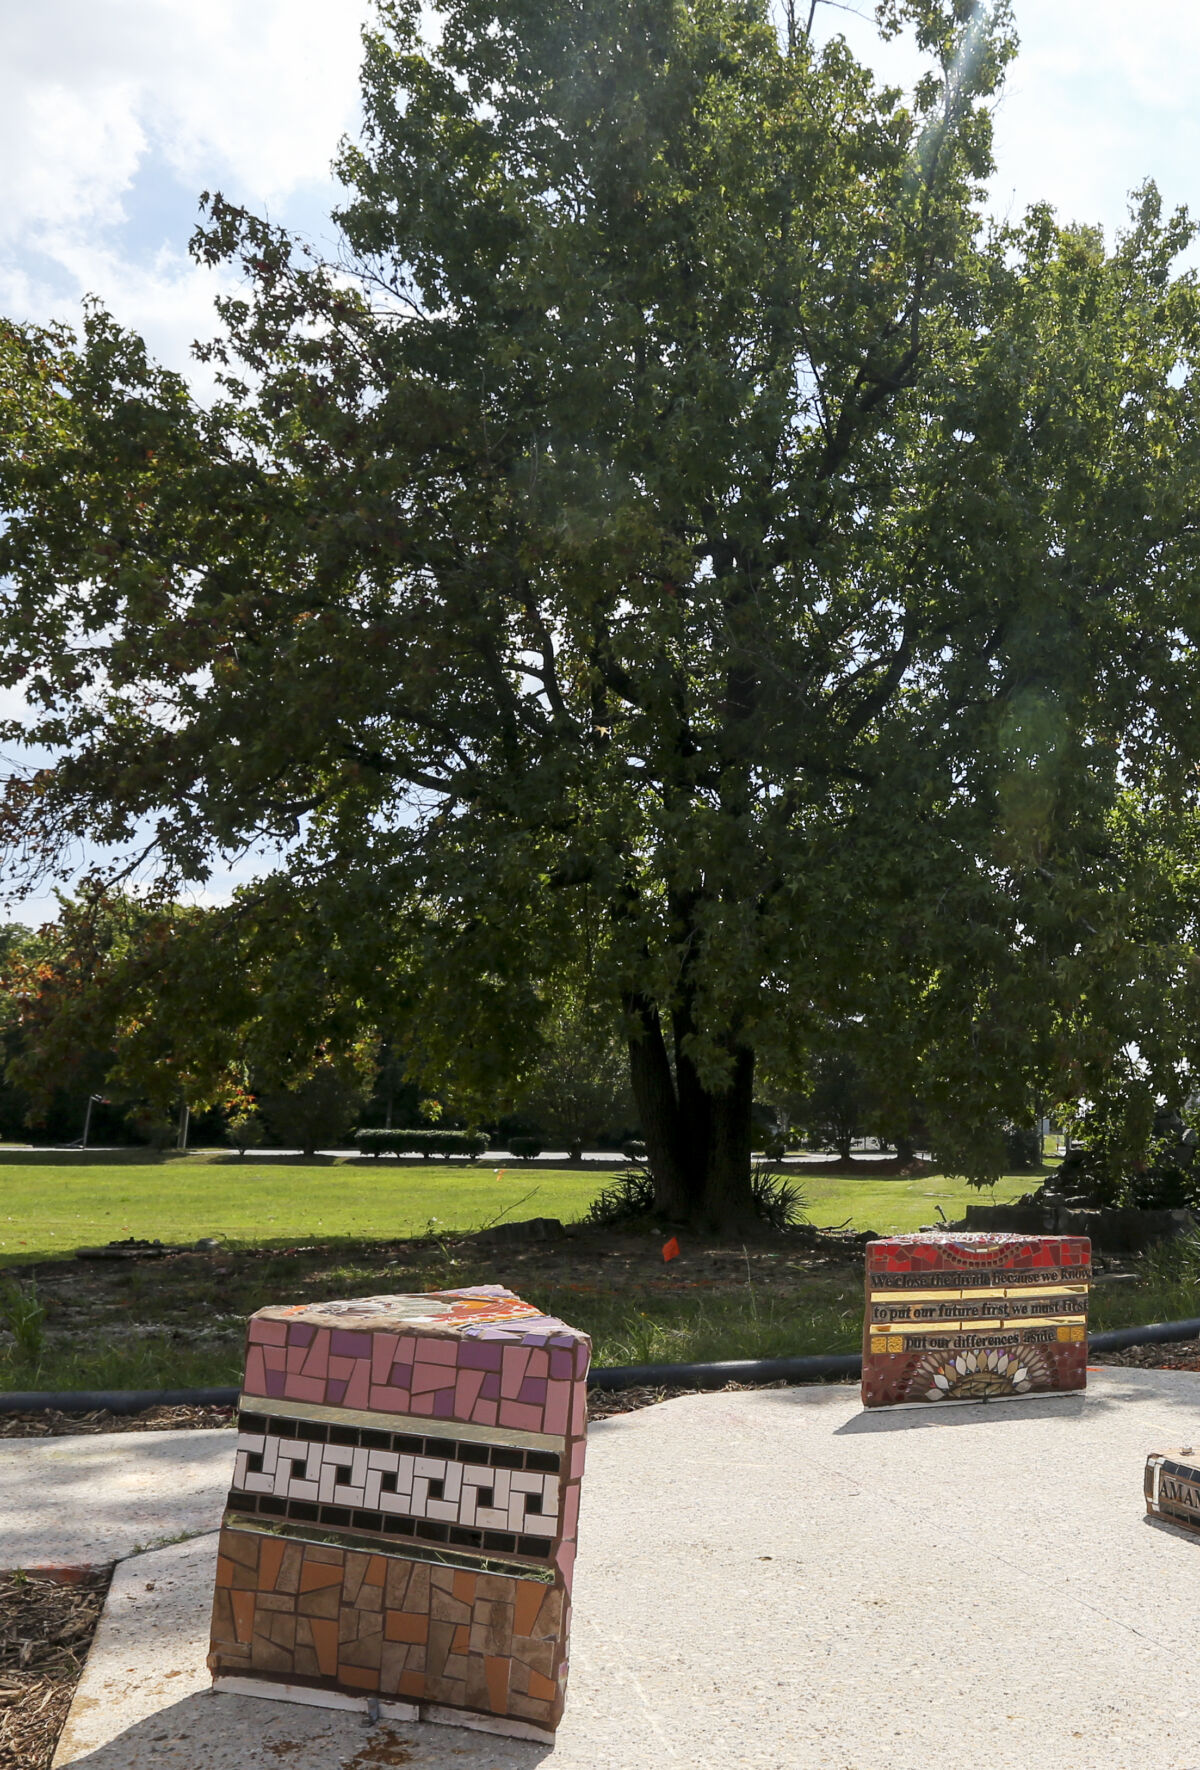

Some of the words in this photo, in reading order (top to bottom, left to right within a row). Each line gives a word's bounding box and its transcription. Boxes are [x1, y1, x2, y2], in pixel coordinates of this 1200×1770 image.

[871, 1275, 893, 1288] We
[894, 1274, 927, 1287] close
[930, 1273, 951, 1286] the
[953, 1271, 989, 1286] divide
[992, 1270, 1039, 1285] because
[1041, 1271, 1058, 1281] we
[874, 1306, 888, 1319] to
[889, 1306, 912, 1321] put
[913, 1306, 936, 1318] our
[938, 1303, 979, 1317] future
[1012, 1304, 1028, 1314] we
[1031, 1302, 1059, 1314] must
[1063, 1299, 1089, 1312] first
[905, 1336, 928, 1351] put
[930, 1336, 952, 1348] our
[953, 1332, 1020, 1348] differences
